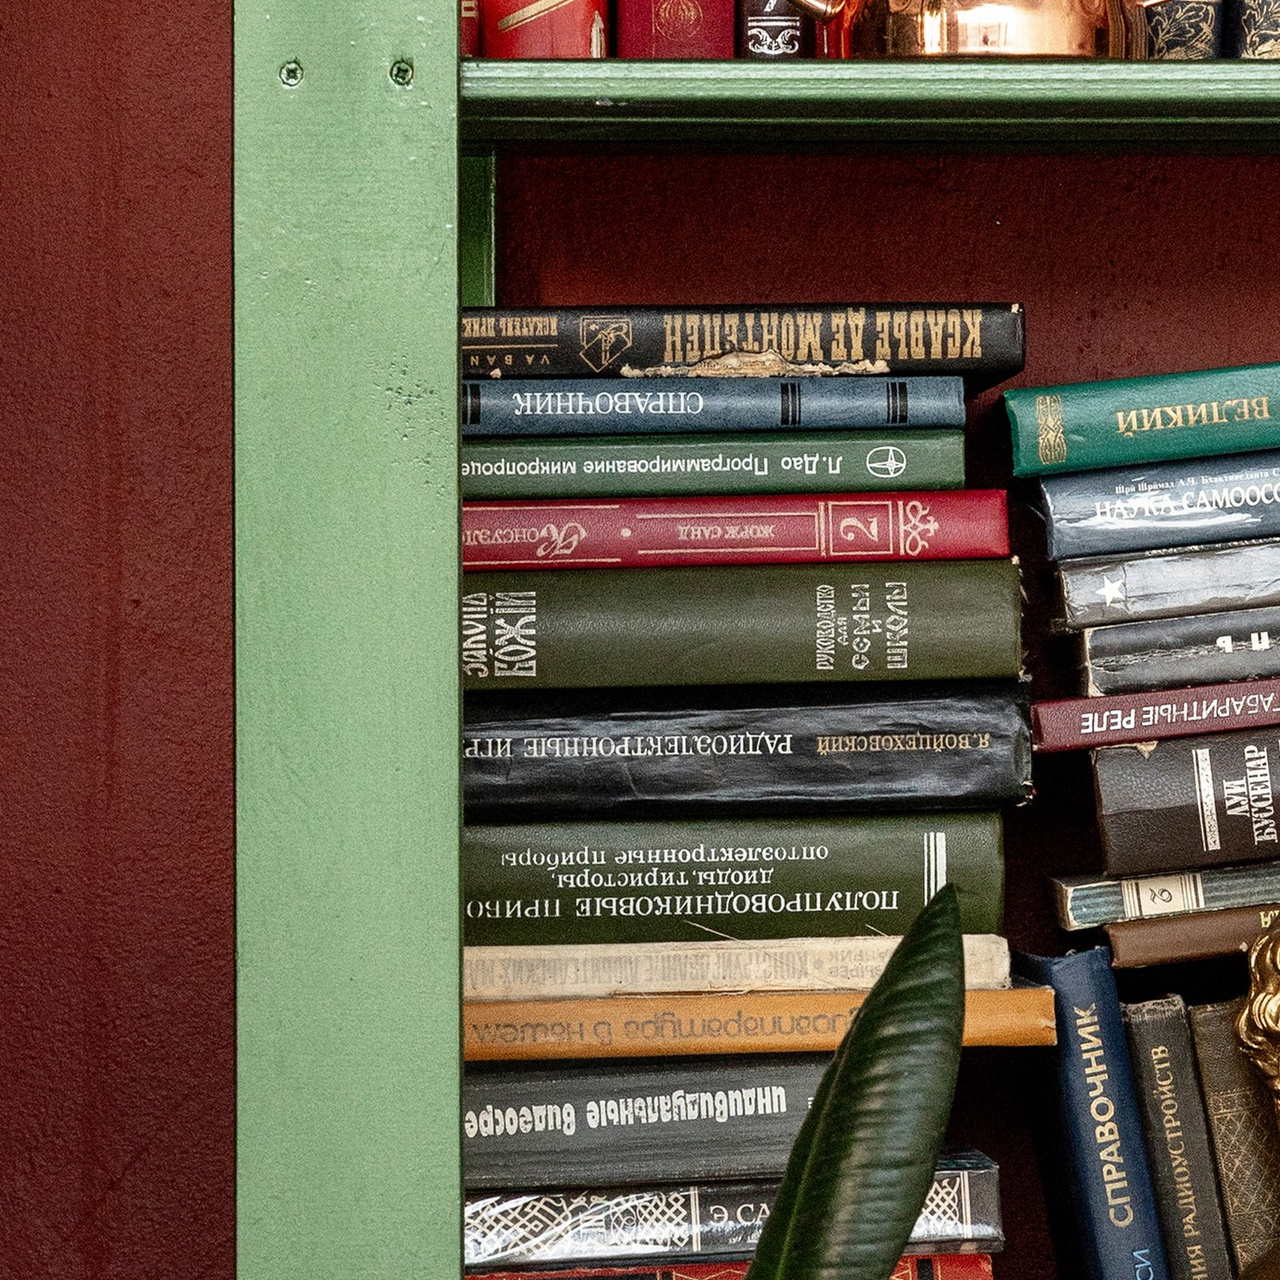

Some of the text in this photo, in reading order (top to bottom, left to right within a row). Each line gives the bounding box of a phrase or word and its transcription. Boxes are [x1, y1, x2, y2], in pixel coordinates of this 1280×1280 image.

[663, 308, 983, 363] КСАВЬЕ ДЕ МОНТЕПЕН
[512, 392, 705, 416] СПРАВОЧНИК
[1115, 395, 1270, 438] ВЕЛИКИЙ
[583, 454, 769, 477] Программирование
[781, 455, 843, 476] Л.Дао
[1094, 494, 1178, 521] НАУКА
[677, 523, 777, 541] ЖОРЖ САНД
[839, 516, 879, 542] 2
[816, 584, 837, 671] РУКОВОДСТВО
[838, 614, 850, 646] ДЛЯ
[851, 583, 871, 671] СЕМЬИ
[886, 581, 909, 670] ШКОЛЫ
[1080, 707, 1136, 735] РЕЛЕ
[523, 733, 794, 758] РАДИОЭЛЕКТРОННЫЕ
[1223, 777, 1251, 820] ЛУИ
[1245, 744, 1279, 846] БУССЕНАР
[501, 844, 829, 869] оптоэлектронные приборы
[551, 868, 774, 890] диоды, тиристоры,
[575, 890, 899, 917] ПОЛУПРОВОДНИКОВЫЕ
[586, 1085, 788, 1129] индивидуальные
[1073, 1002, 1135, 1229] СПРАВОЧНИК
[1151, 1044, 1198, 1236] РАДИОУСТРОЙСТВ
